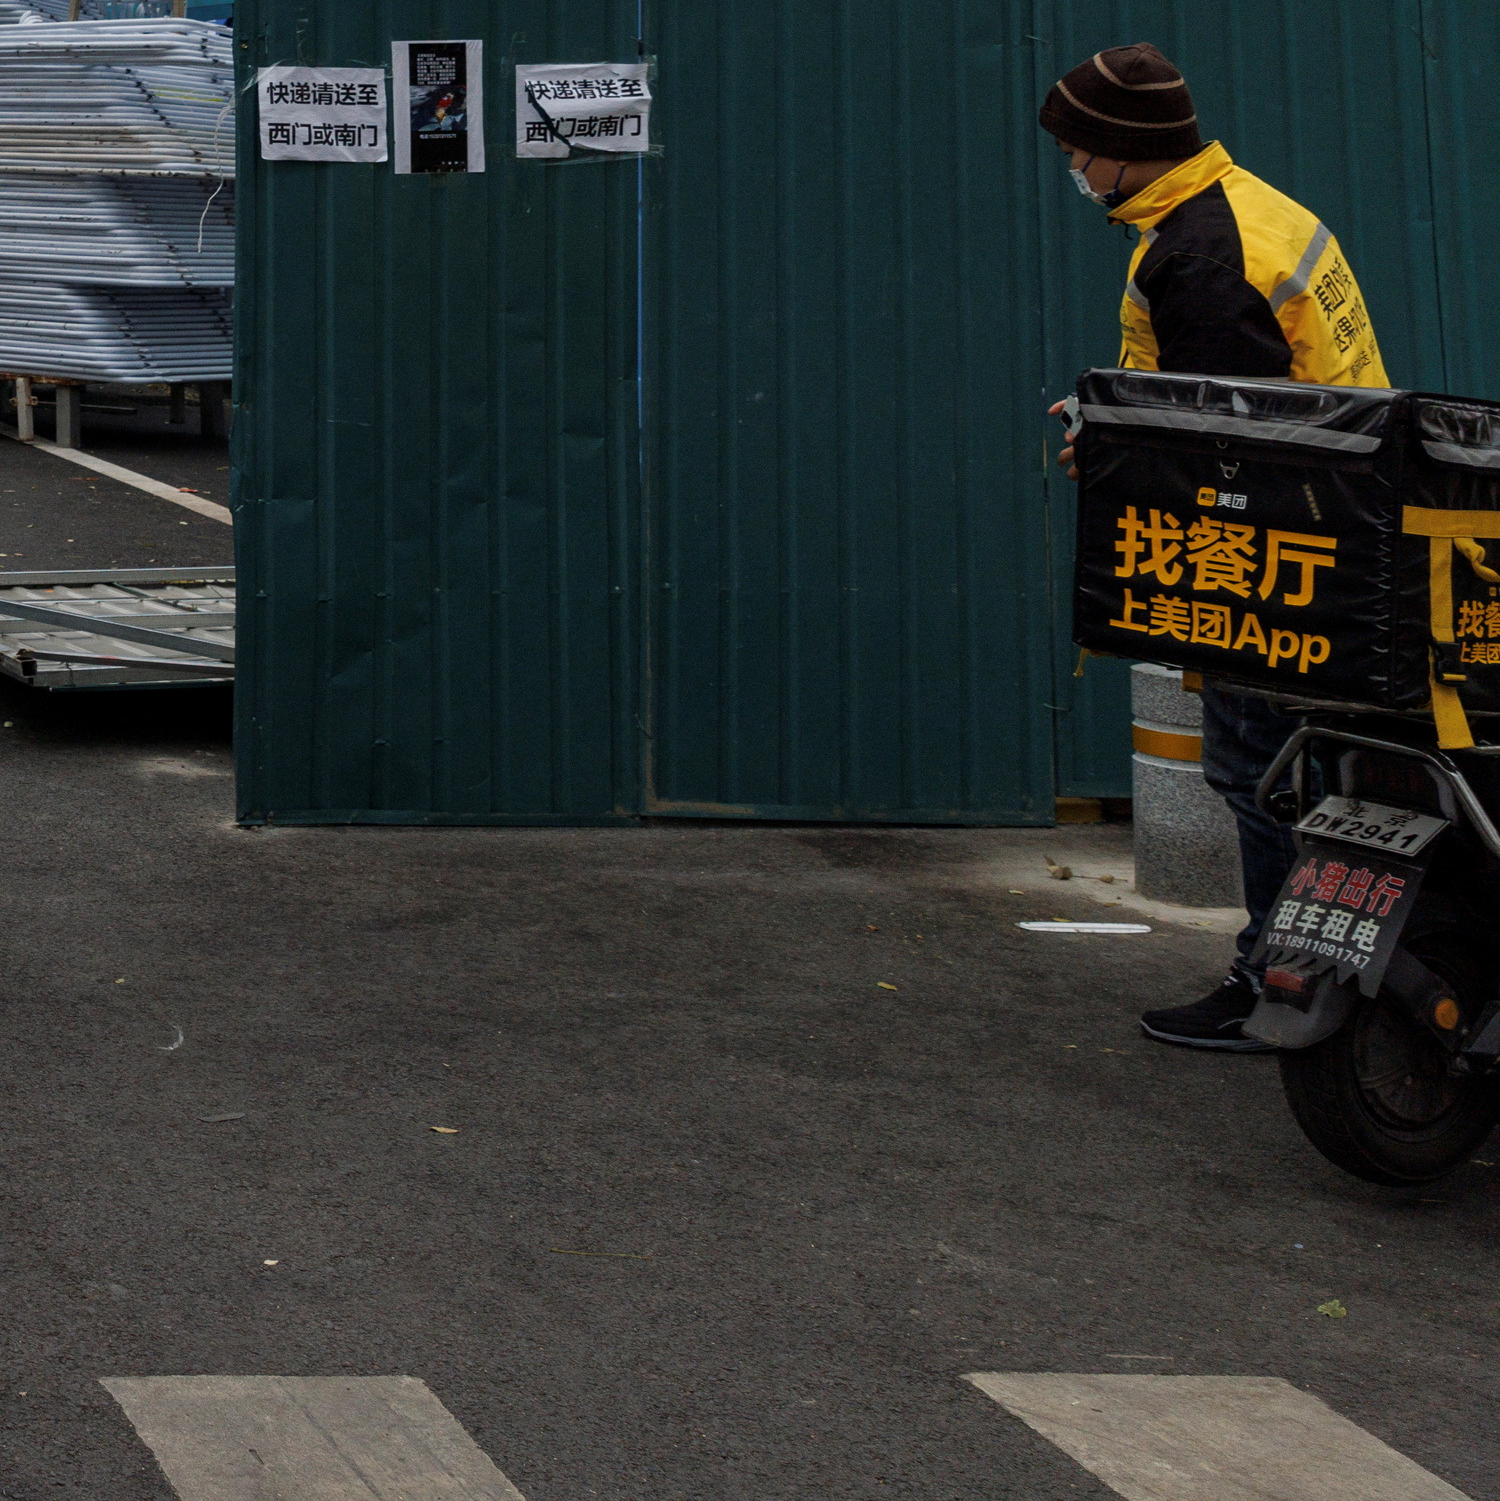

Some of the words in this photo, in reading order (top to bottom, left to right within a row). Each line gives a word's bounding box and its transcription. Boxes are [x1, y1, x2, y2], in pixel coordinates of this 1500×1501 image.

[266, 82, 379, 106] 快递请送至
[526, 79, 643, 102] 快递请送至
[268, 123, 378, 147] 西门或南门
[526, 114, 641, 143] 西门或南门
[1217, 492, 1248, 510] 美团
[1114, 504, 1338, 607] 找餐厅
[1109, 588, 1332, 674] 上美团App
[1306, 811, 1419, 850] DW2941
[1291, 857, 1406, 917] 小猪出行
[1273, 898, 1381, 953] 租车租电
